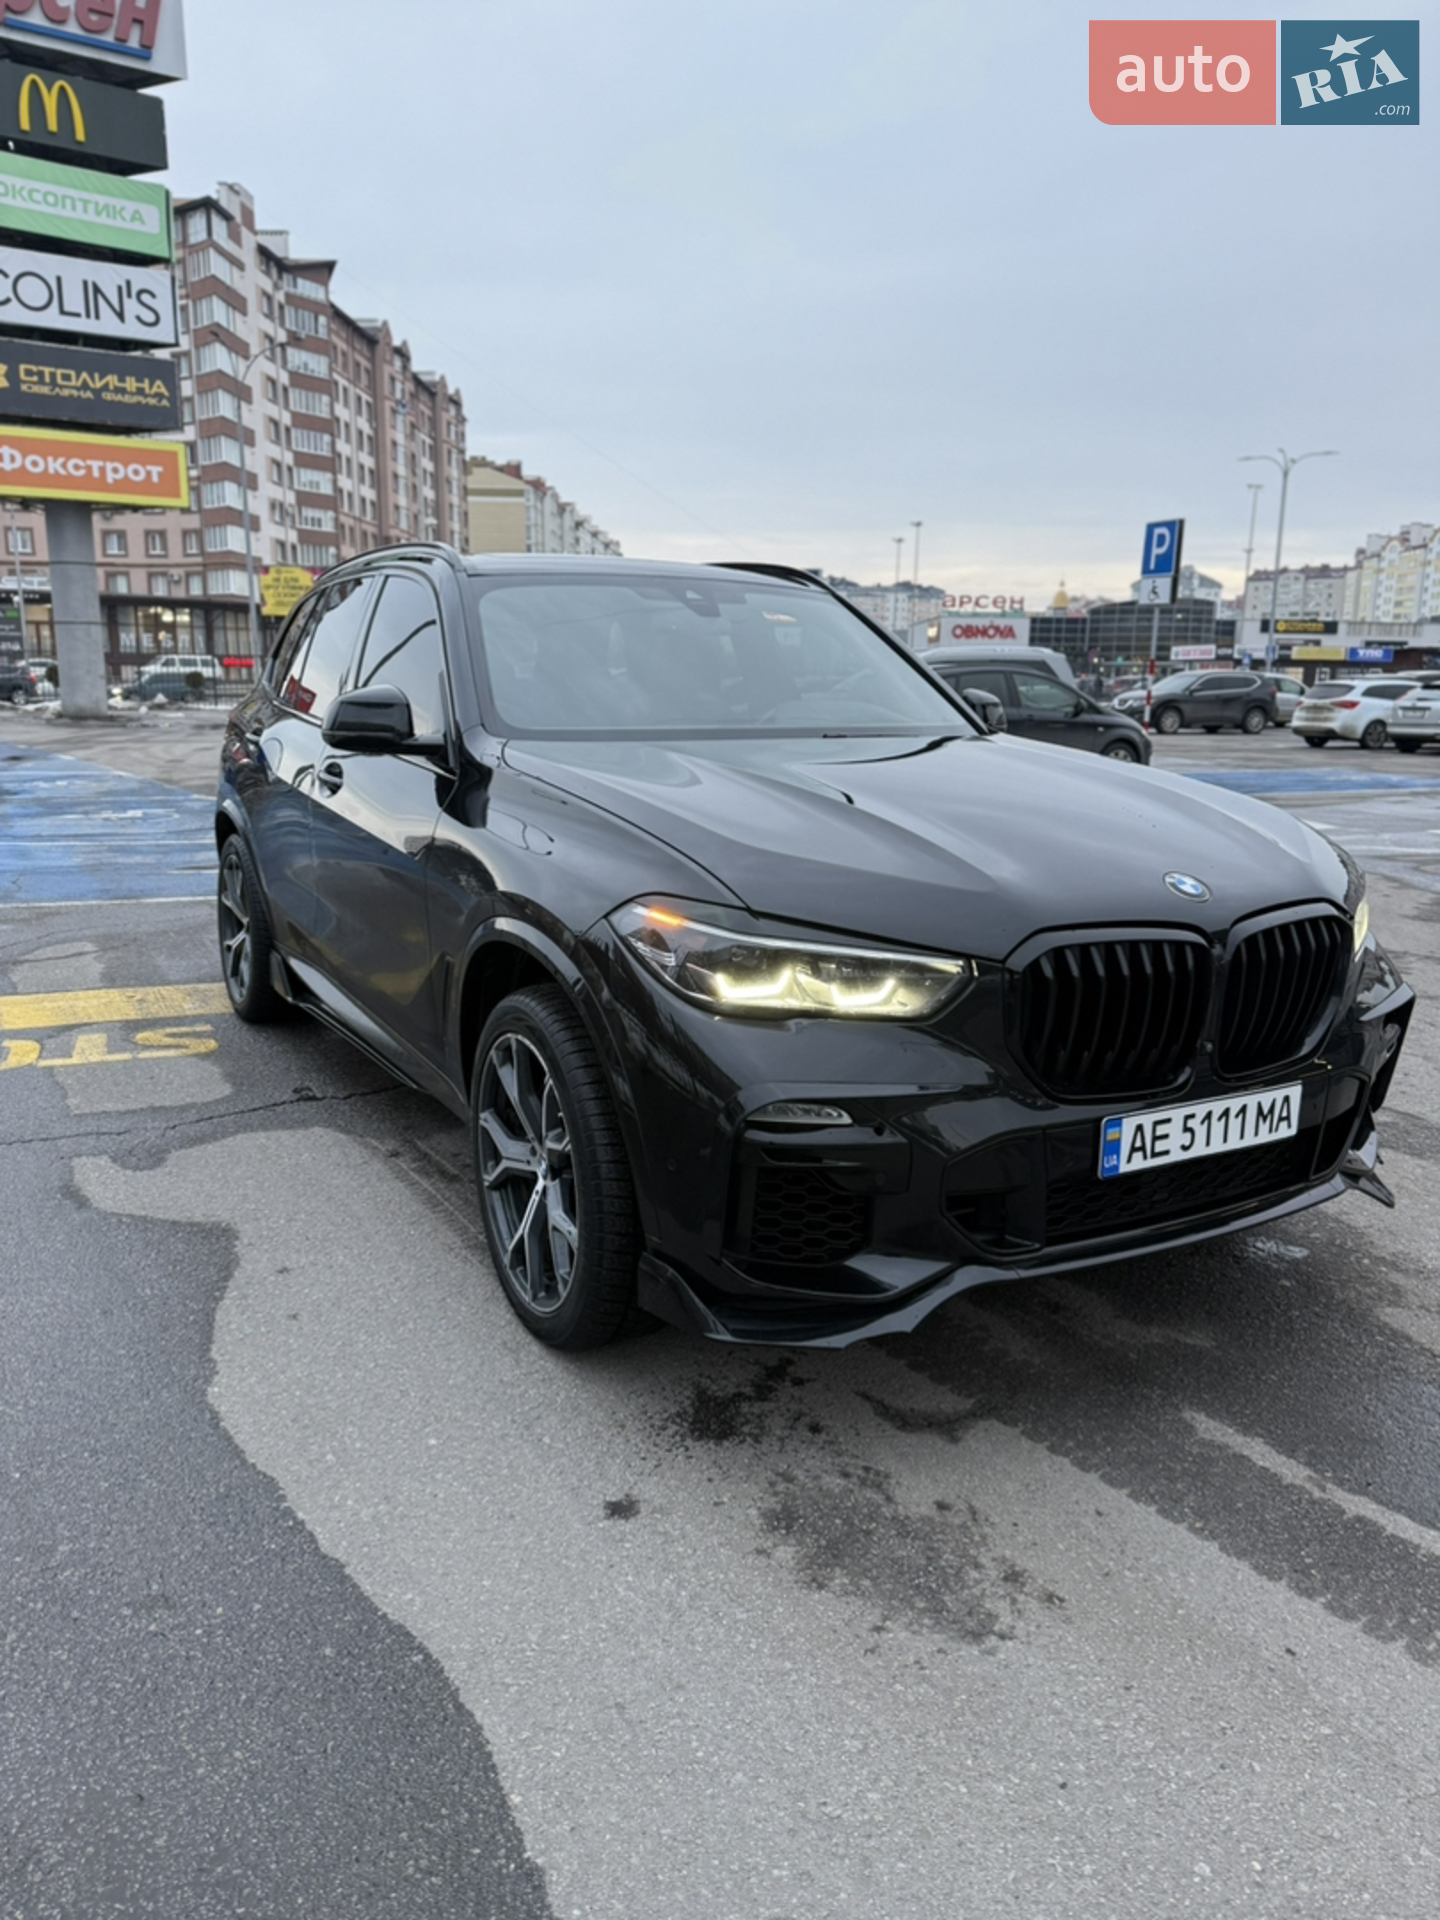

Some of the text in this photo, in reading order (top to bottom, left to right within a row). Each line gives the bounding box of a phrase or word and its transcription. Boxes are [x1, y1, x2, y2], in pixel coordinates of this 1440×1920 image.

[0, 268, 161, 328] OLIN'S
[19, 364, 170, 397] СТОЛИЧНА
[1149, 526, 1171, 571] P
[1126, 1094, 1292, 1164] AE 5111 MA
